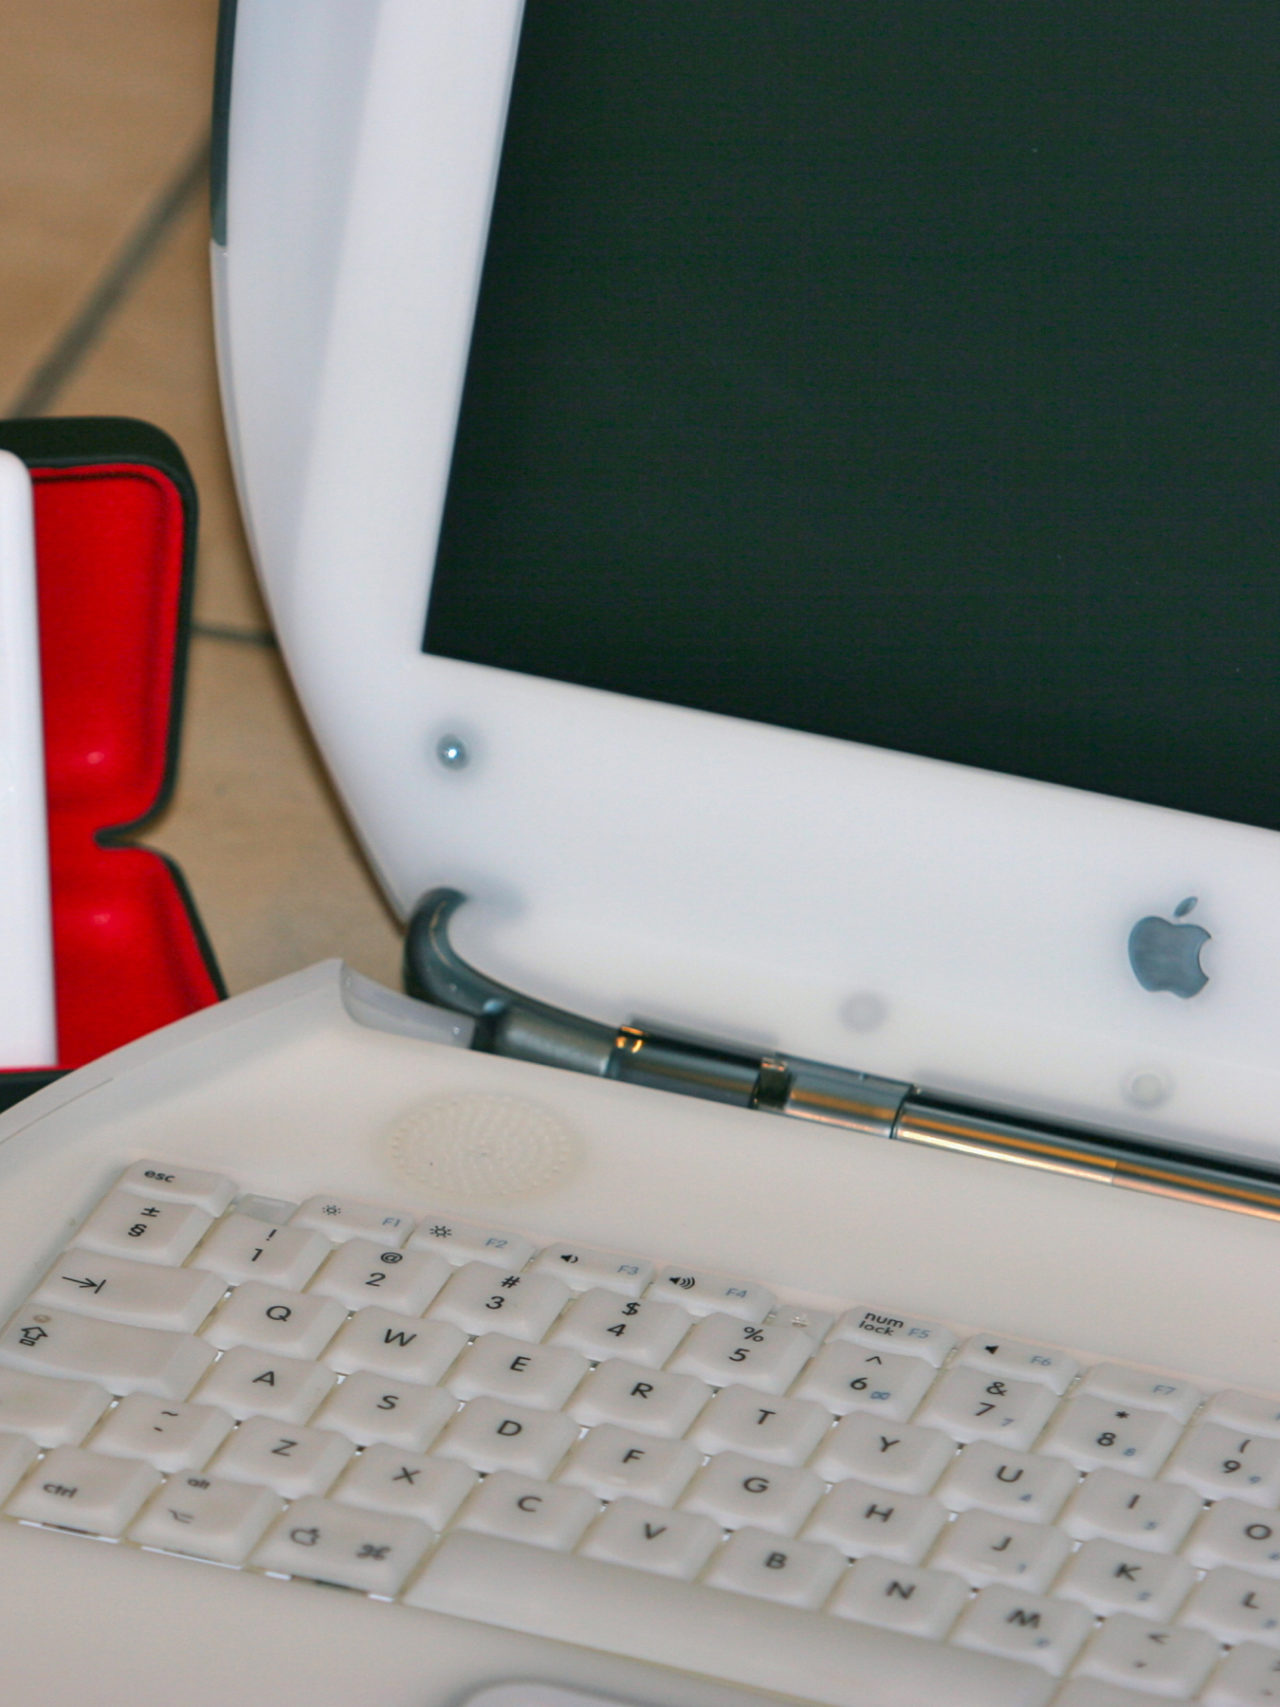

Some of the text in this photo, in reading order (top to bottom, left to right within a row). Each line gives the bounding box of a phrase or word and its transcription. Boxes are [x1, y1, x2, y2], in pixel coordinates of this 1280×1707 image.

[144, 1169, 176, 1184] esc
[382, 1217, 402, 1228] F1
[266, 1229, 278, 1242] !
[485, 1238, 509, 1249] F2
[252, 1249, 264, 1262] 1
[381, 1252, 404, 1265] @
[617, 1265, 640, 1276] F3
[366, 1273, 387, 1287] 2
[502, 1276, 521, 1289] #
[725, 1288, 748, 1299] F4
[486, 1296, 506, 1310] 3
[622, 1302, 641, 1317] $
[266, 1306, 292, 1323] Q
[864, 1312, 904, 1328] num
[607, 1324, 627, 1337] 4
[744, 1327, 765, 1343] %
[859, 1320, 894, 1336] lock
[907, 1328, 931, 1340] F5
[384, 1329, 417, 1348] W
[729, 1348, 751, 1363] 5
[1029, 1356, 1052, 1367] F6
[510, 1356, 532, 1373] E
[253, 1371, 275, 1387] A
[850, 1378, 868, 1391] 6
[631, 1383, 654, 1399] R
[986, 1382, 1007, 1397] &
[1152, 1384, 1177, 1396] F7
[377, 1396, 400, 1411] S
[976, 1402, 997, 1417] 7
[758, 1410, 777, 1425] T
[497, 1420, 523, 1437] D
[881, 1437, 900, 1453] Y
[1097, 1432, 1117, 1447] 8
[272, 1440, 299, 1457] Z
[622, 1449, 645, 1464] F
[1223, 1460, 1242, 1474] 9
[393, 1467, 421, 1485] X
[996, 1466, 1024, 1484] U
[43, 1484, 79, 1499] ctrl
[743, 1477, 770, 1494] G
[517, 1496, 543, 1513] C
[865, 1504, 895, 1523] H
[645, 1524, 667, 1541] V
[1244, 1524, 1273, 1541] O
[992, 1537, 1013, 1553] J
[765, 1552, 788, 1570] B
[1115, 1564, 1141, 1582] K
[886, 1581, 916, 1601] N
[1242, 1592, 1259, 1610] L
[1008, 1610, 1042, 1629] M
